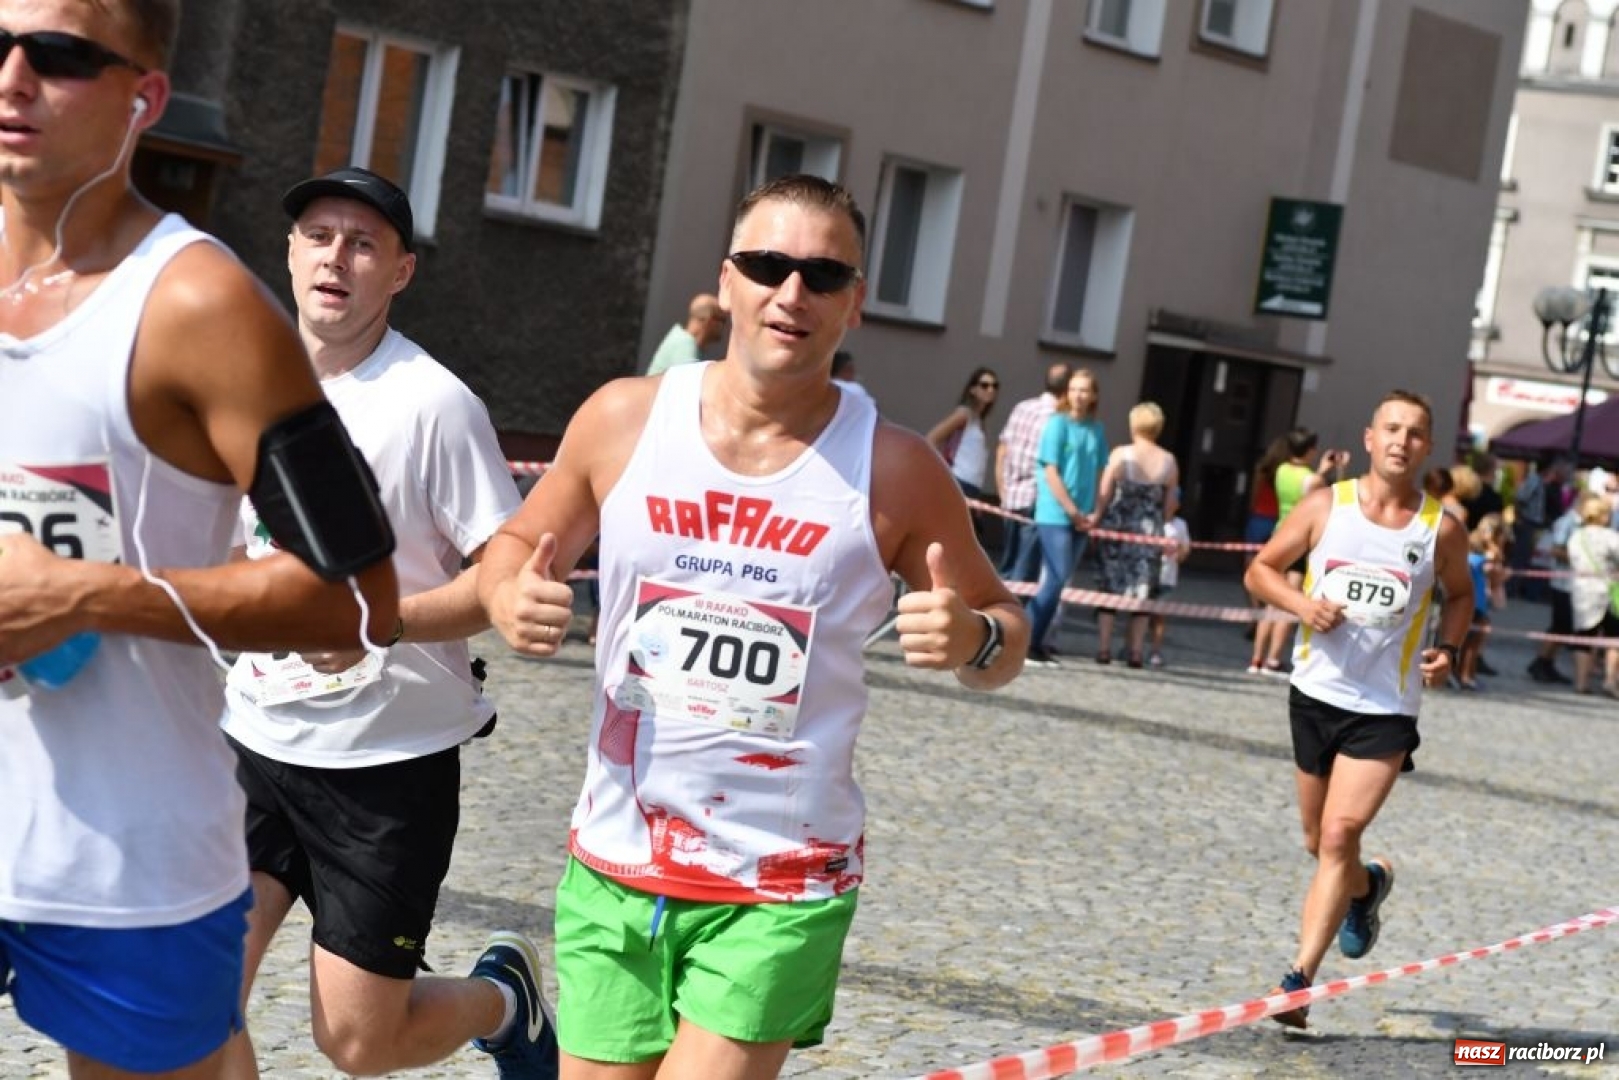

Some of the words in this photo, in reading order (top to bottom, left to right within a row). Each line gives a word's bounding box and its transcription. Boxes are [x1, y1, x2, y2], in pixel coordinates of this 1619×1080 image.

[646, 489, 830, 557] RAFAKO
[675, 554, 733, 577] GRUPA
[741, 563, 778, 583] PBG
[1347, 579, 1395, 607] 879
[706, 600, 749, 618] RAFAKO
[680, 626, 780, 685] 700
